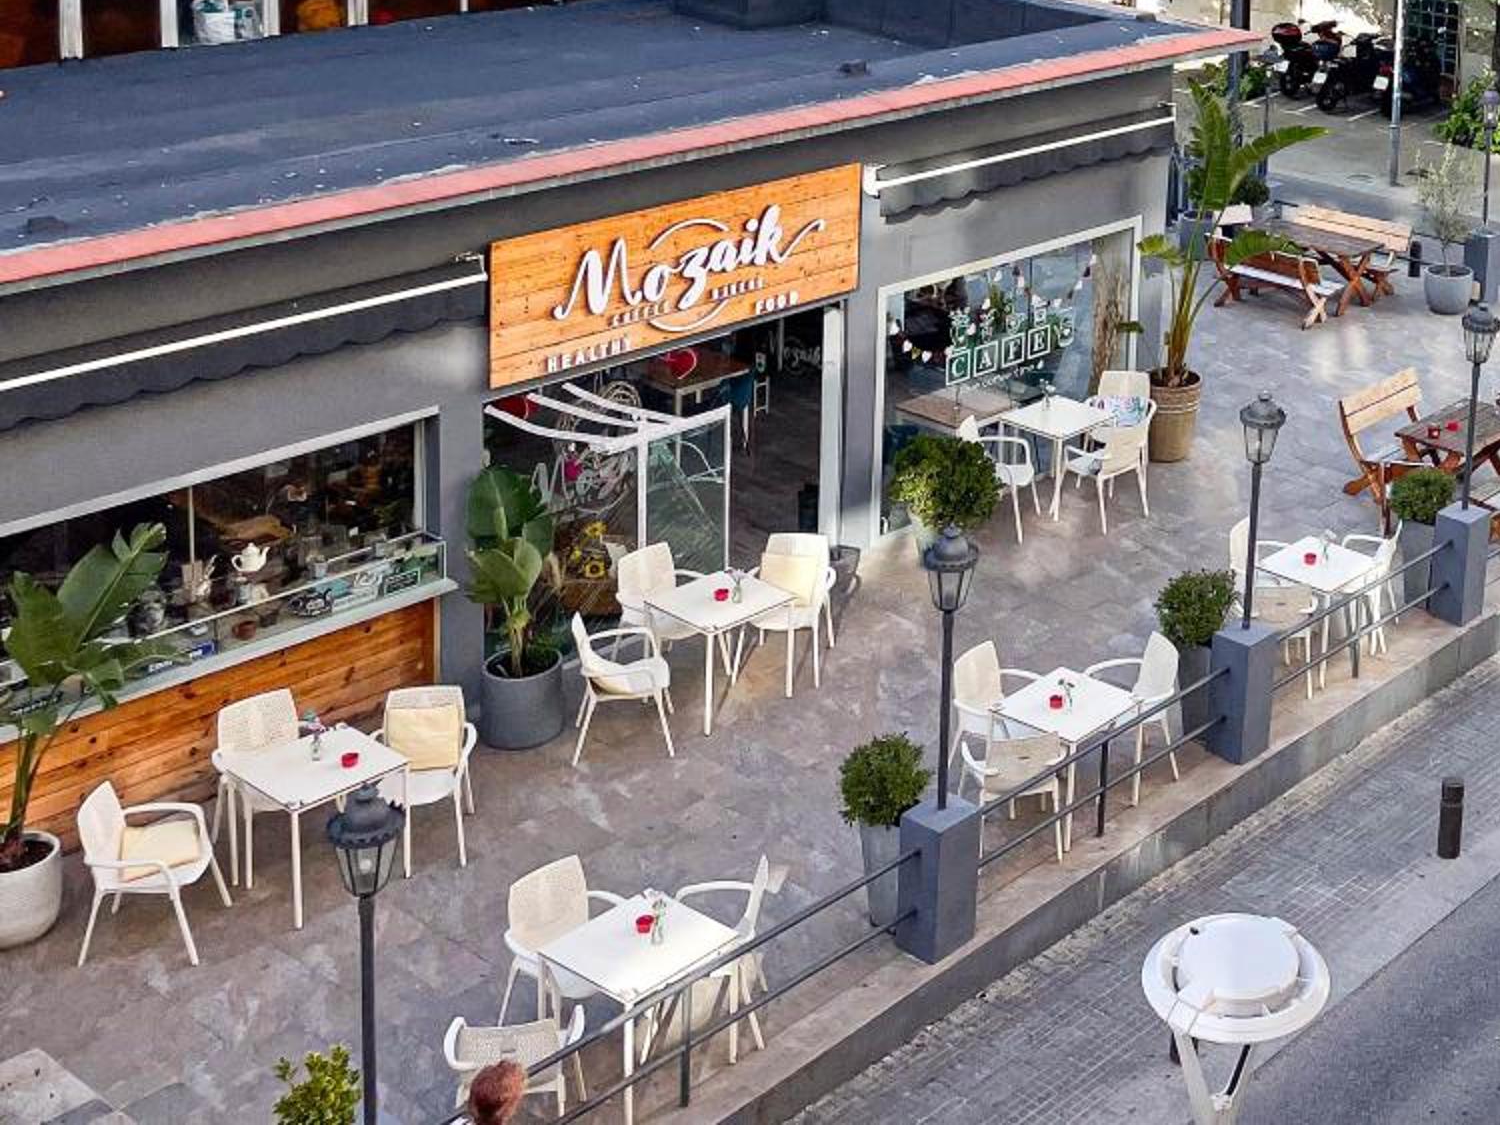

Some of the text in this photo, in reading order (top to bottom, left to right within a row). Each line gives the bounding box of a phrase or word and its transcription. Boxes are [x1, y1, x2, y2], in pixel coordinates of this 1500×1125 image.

[552, 203, 826, 321] Mozaik
[755, 291, 800, 316] FOOD
[547, 336, 632, 373] HEALTHY
[948, 327, 1048, 382] CAFE
